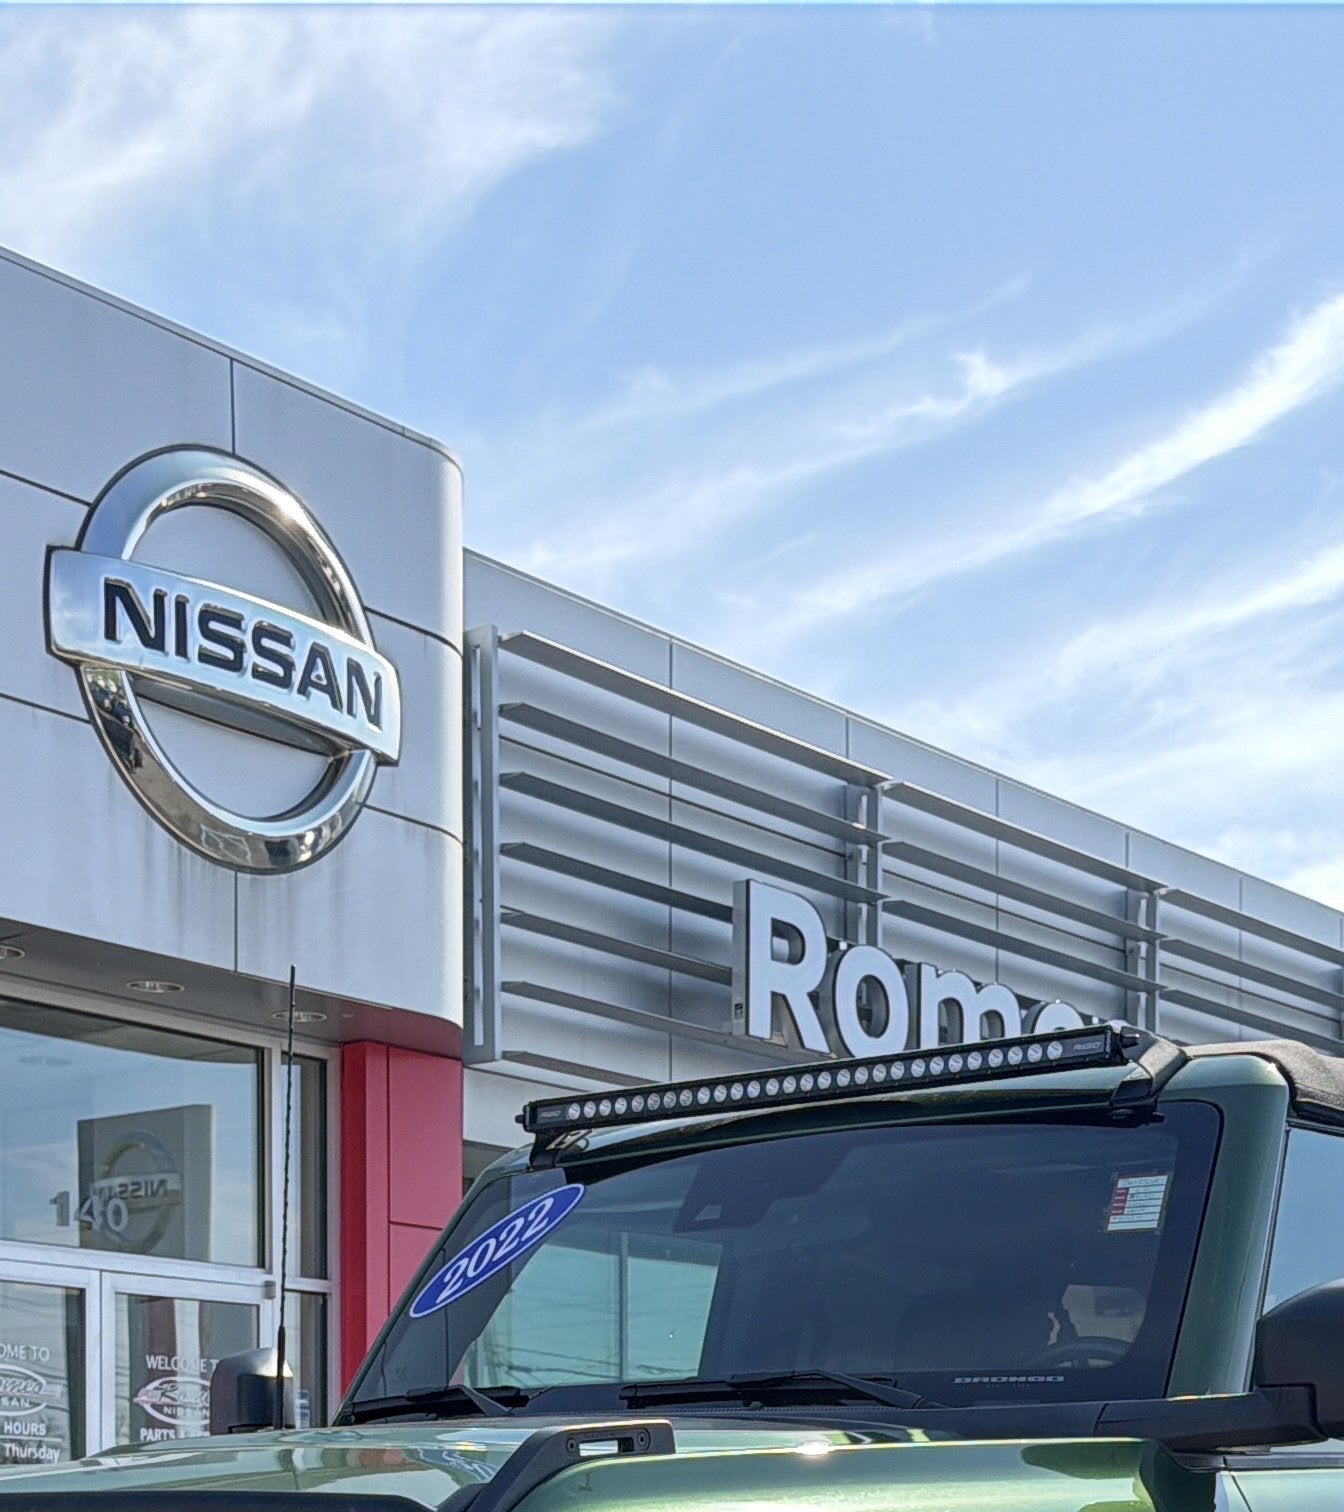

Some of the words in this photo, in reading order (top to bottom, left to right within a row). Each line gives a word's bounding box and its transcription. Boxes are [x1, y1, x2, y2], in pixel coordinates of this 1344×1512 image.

[104, 577, 382, 732] NISSAN
[746, 878, 1086, 1057] Rom
[49, 1190, 129, 1232] 140
[436, 1197, 555, 1304] 2022
[30, 1345, 50, 1362] TO
[4, 1420, 47, 1436] HOURS
[2, 1442, 61, 1464] Thursday
